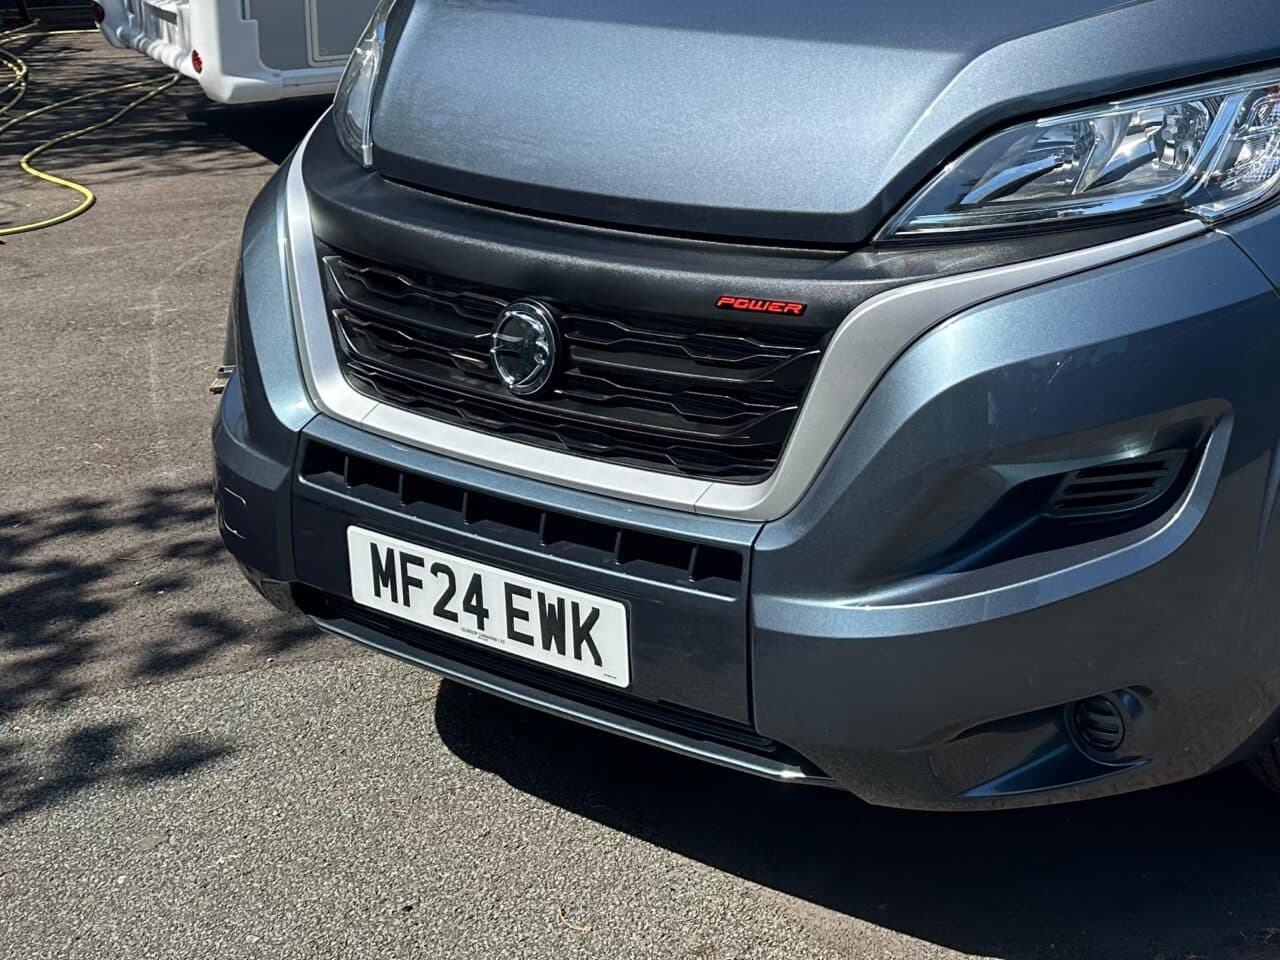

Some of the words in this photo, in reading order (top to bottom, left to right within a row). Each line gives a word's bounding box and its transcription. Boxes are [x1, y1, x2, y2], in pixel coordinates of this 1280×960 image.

[716, 297, 803, 314] POWER
[370, 542, 490, 631] MF24
[504, 581, 603, 668] EWK
